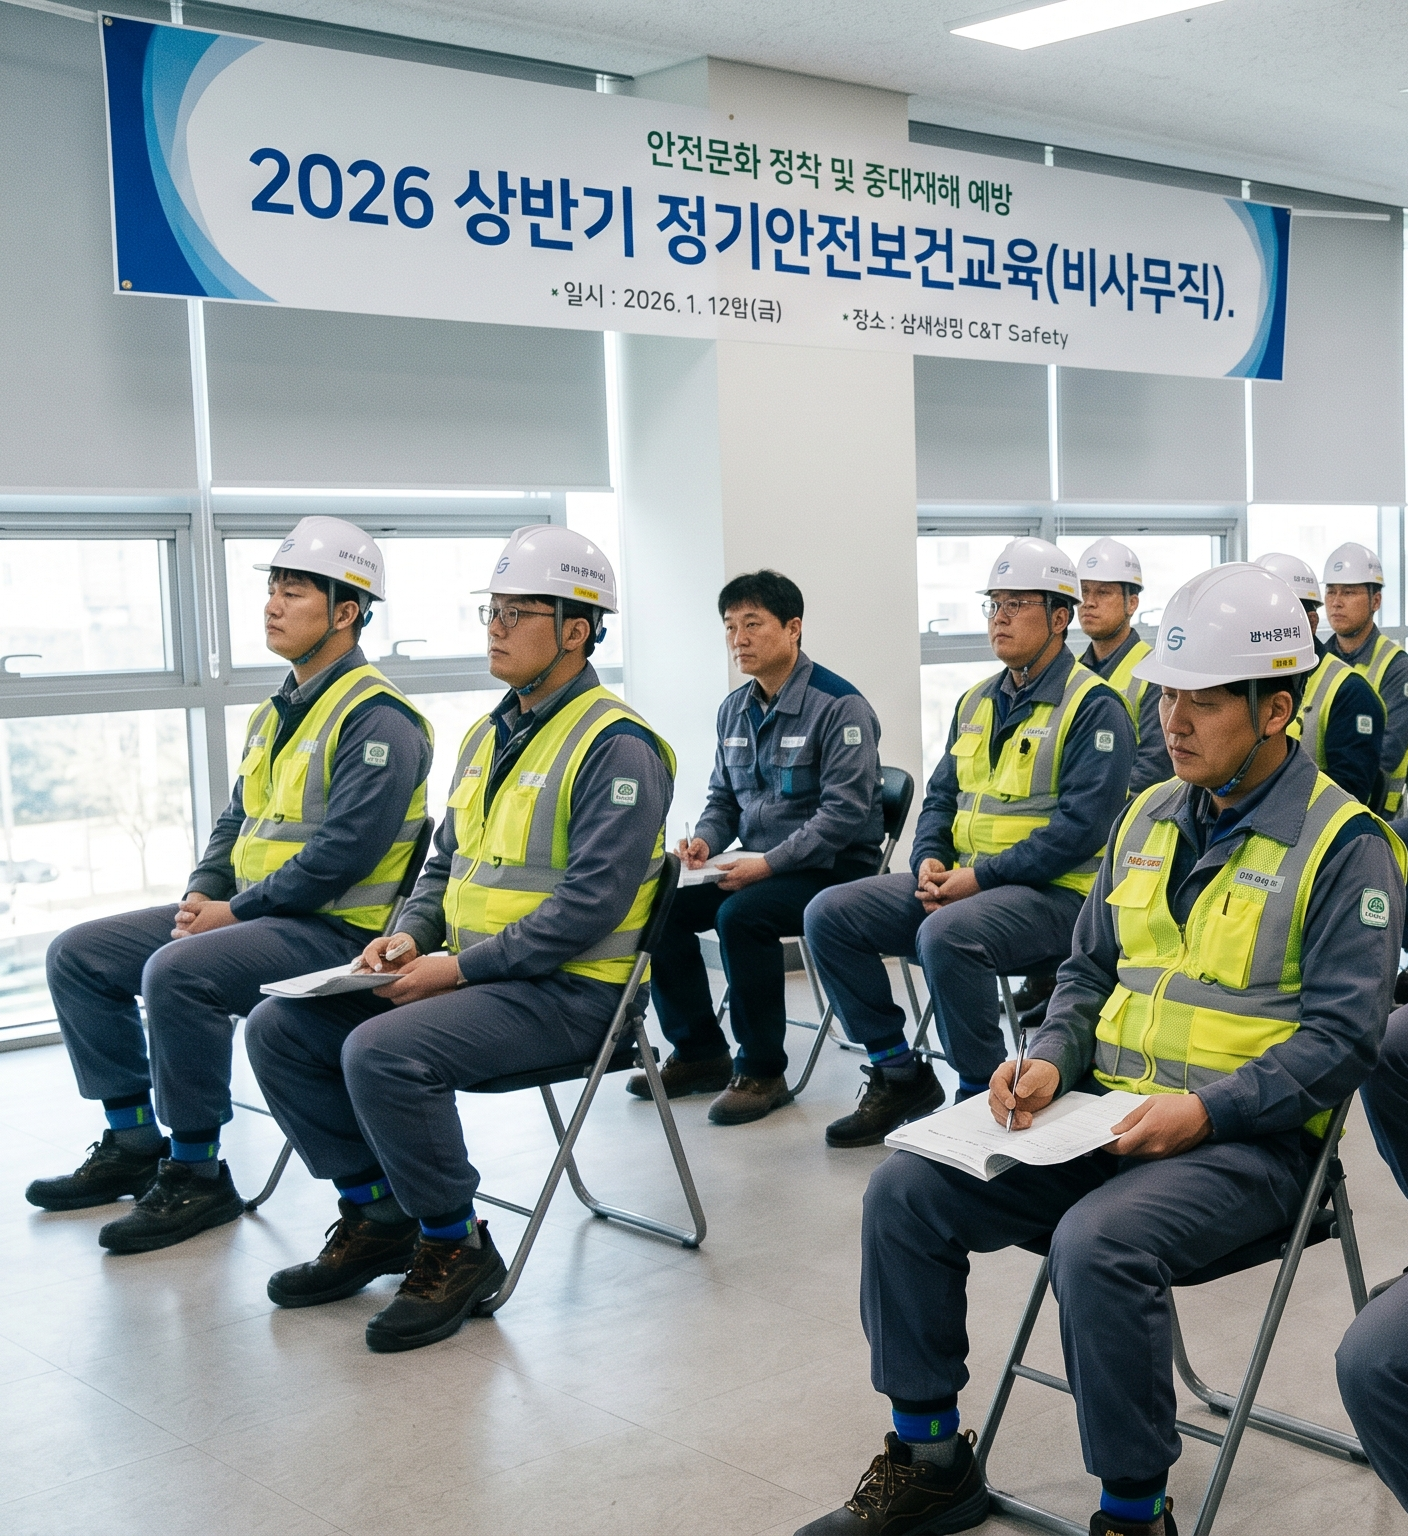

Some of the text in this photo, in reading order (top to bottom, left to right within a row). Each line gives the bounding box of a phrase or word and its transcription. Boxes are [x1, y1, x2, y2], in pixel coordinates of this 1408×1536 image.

[646, 129, 1014, 217] 안전문화 정착 및 중대재해 예방
[248, 146, 1236, 323] 2026 상반기 정기안전보건교육(비사무직).
[967, 321, 1003, 341] C&T
[1008, 324, 1070, 351] Safety
